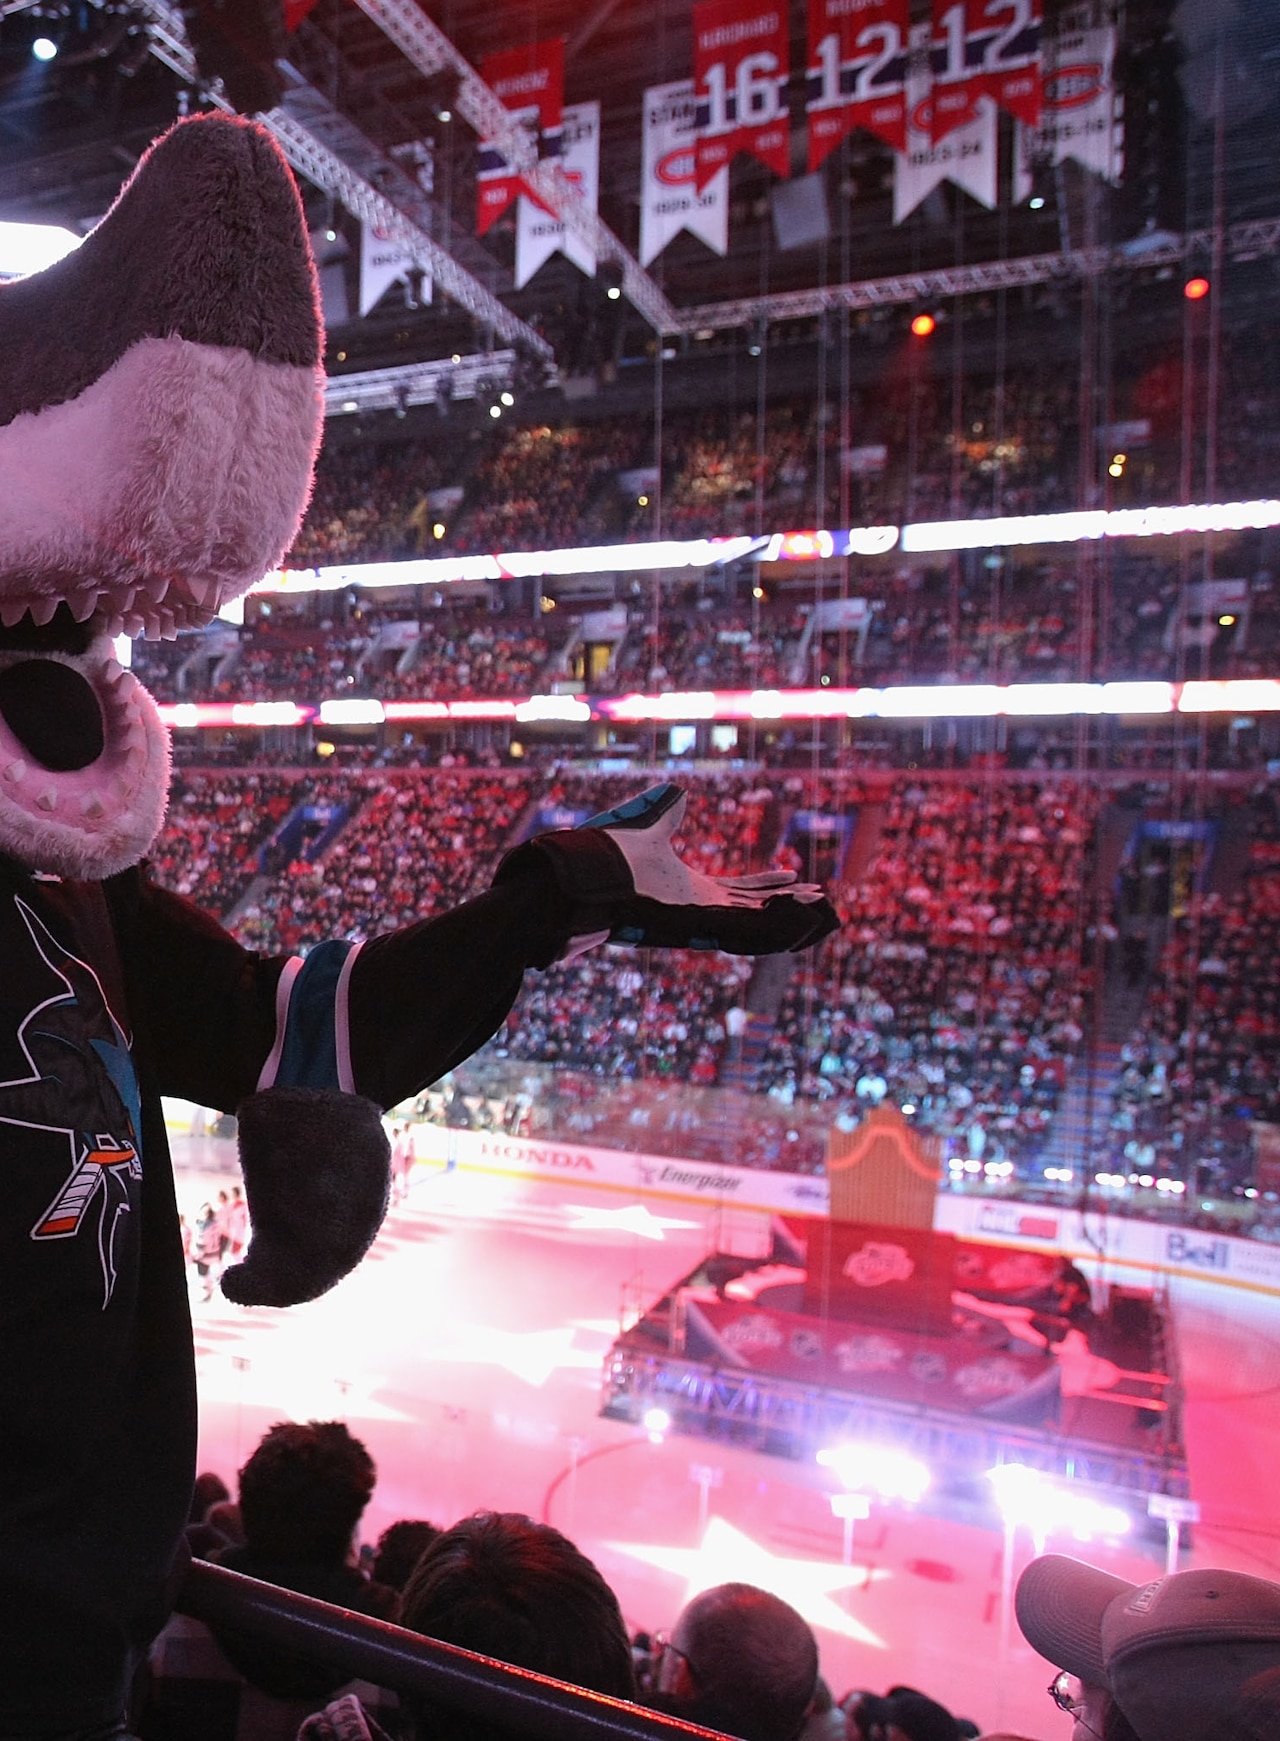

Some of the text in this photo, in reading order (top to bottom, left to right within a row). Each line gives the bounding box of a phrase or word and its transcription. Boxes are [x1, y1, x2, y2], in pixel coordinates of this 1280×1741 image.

[806, 21, 903, 112] 12
[937, 0, 1038, 84] 12
[703, 51, 780, 137] 16
[481, 1142, 597, 1172] HONDA
[659, 1165, 743, 1192] Energizer
[1167, 1232, 1229, 1270] Bell
